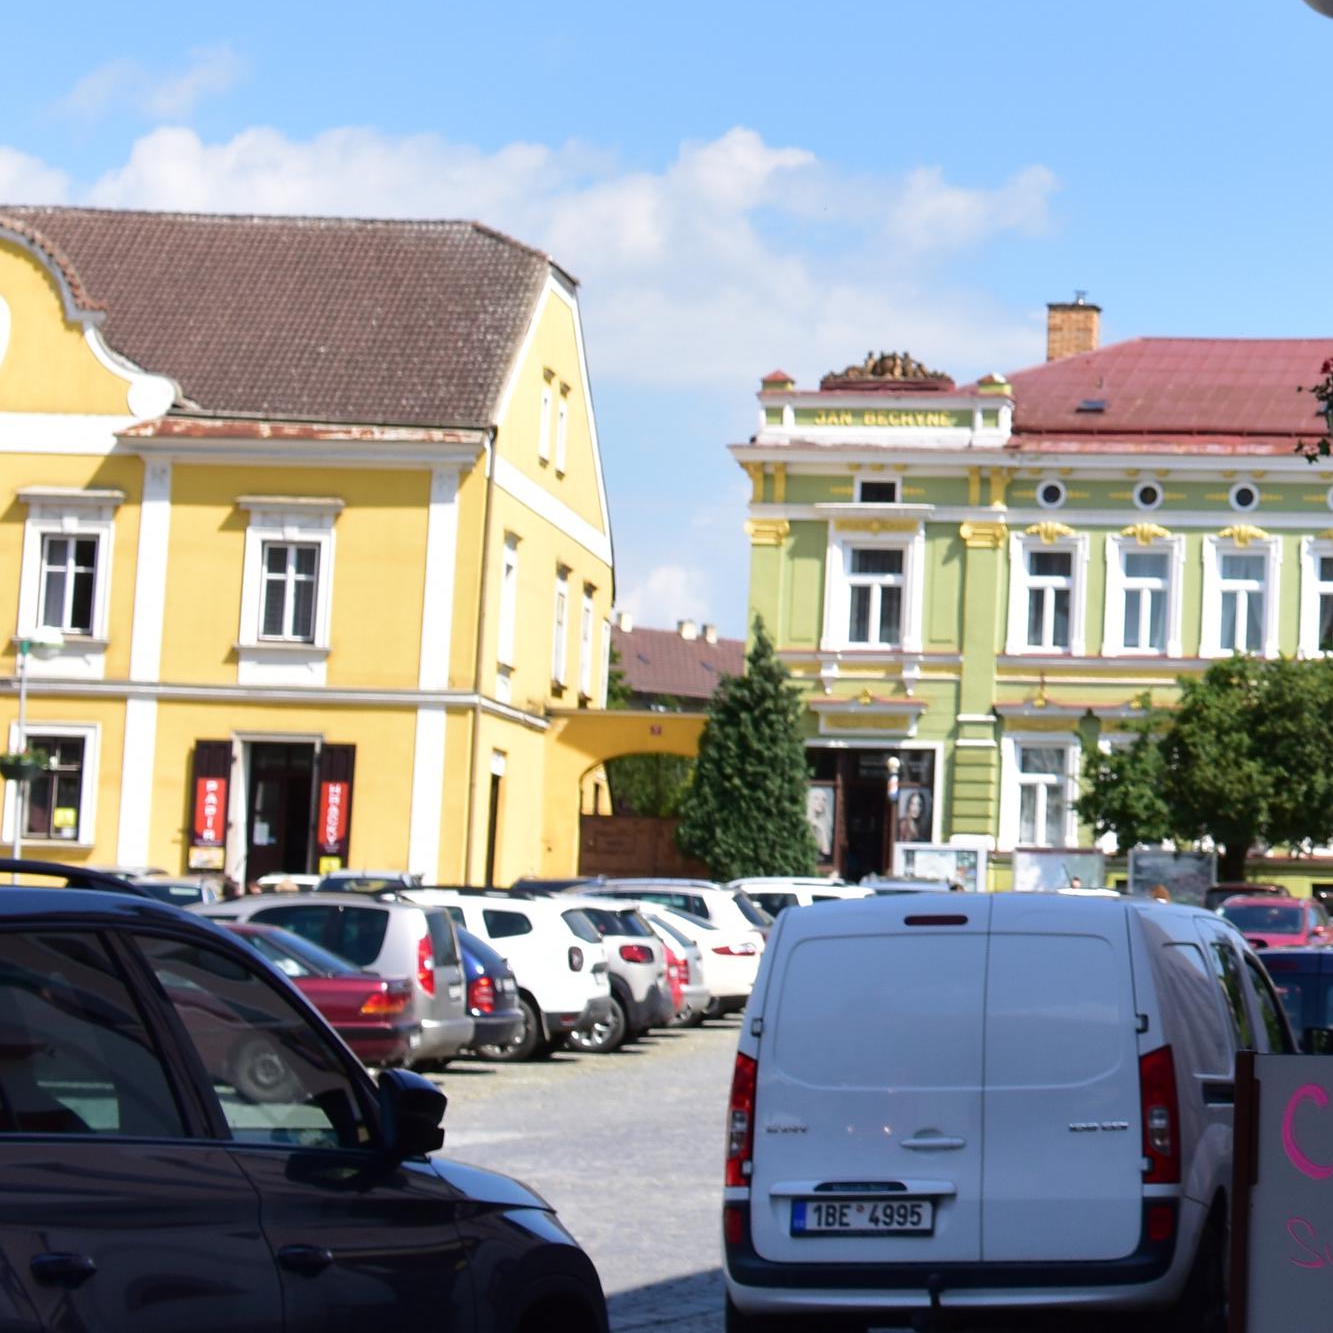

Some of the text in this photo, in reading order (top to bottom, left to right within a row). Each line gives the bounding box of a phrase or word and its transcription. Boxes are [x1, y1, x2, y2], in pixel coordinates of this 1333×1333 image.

[815, 410, 852, 426] JAN
[813, 1203, 851, 1227] 1BE
[868, 1203, 923, 1227] 4995
